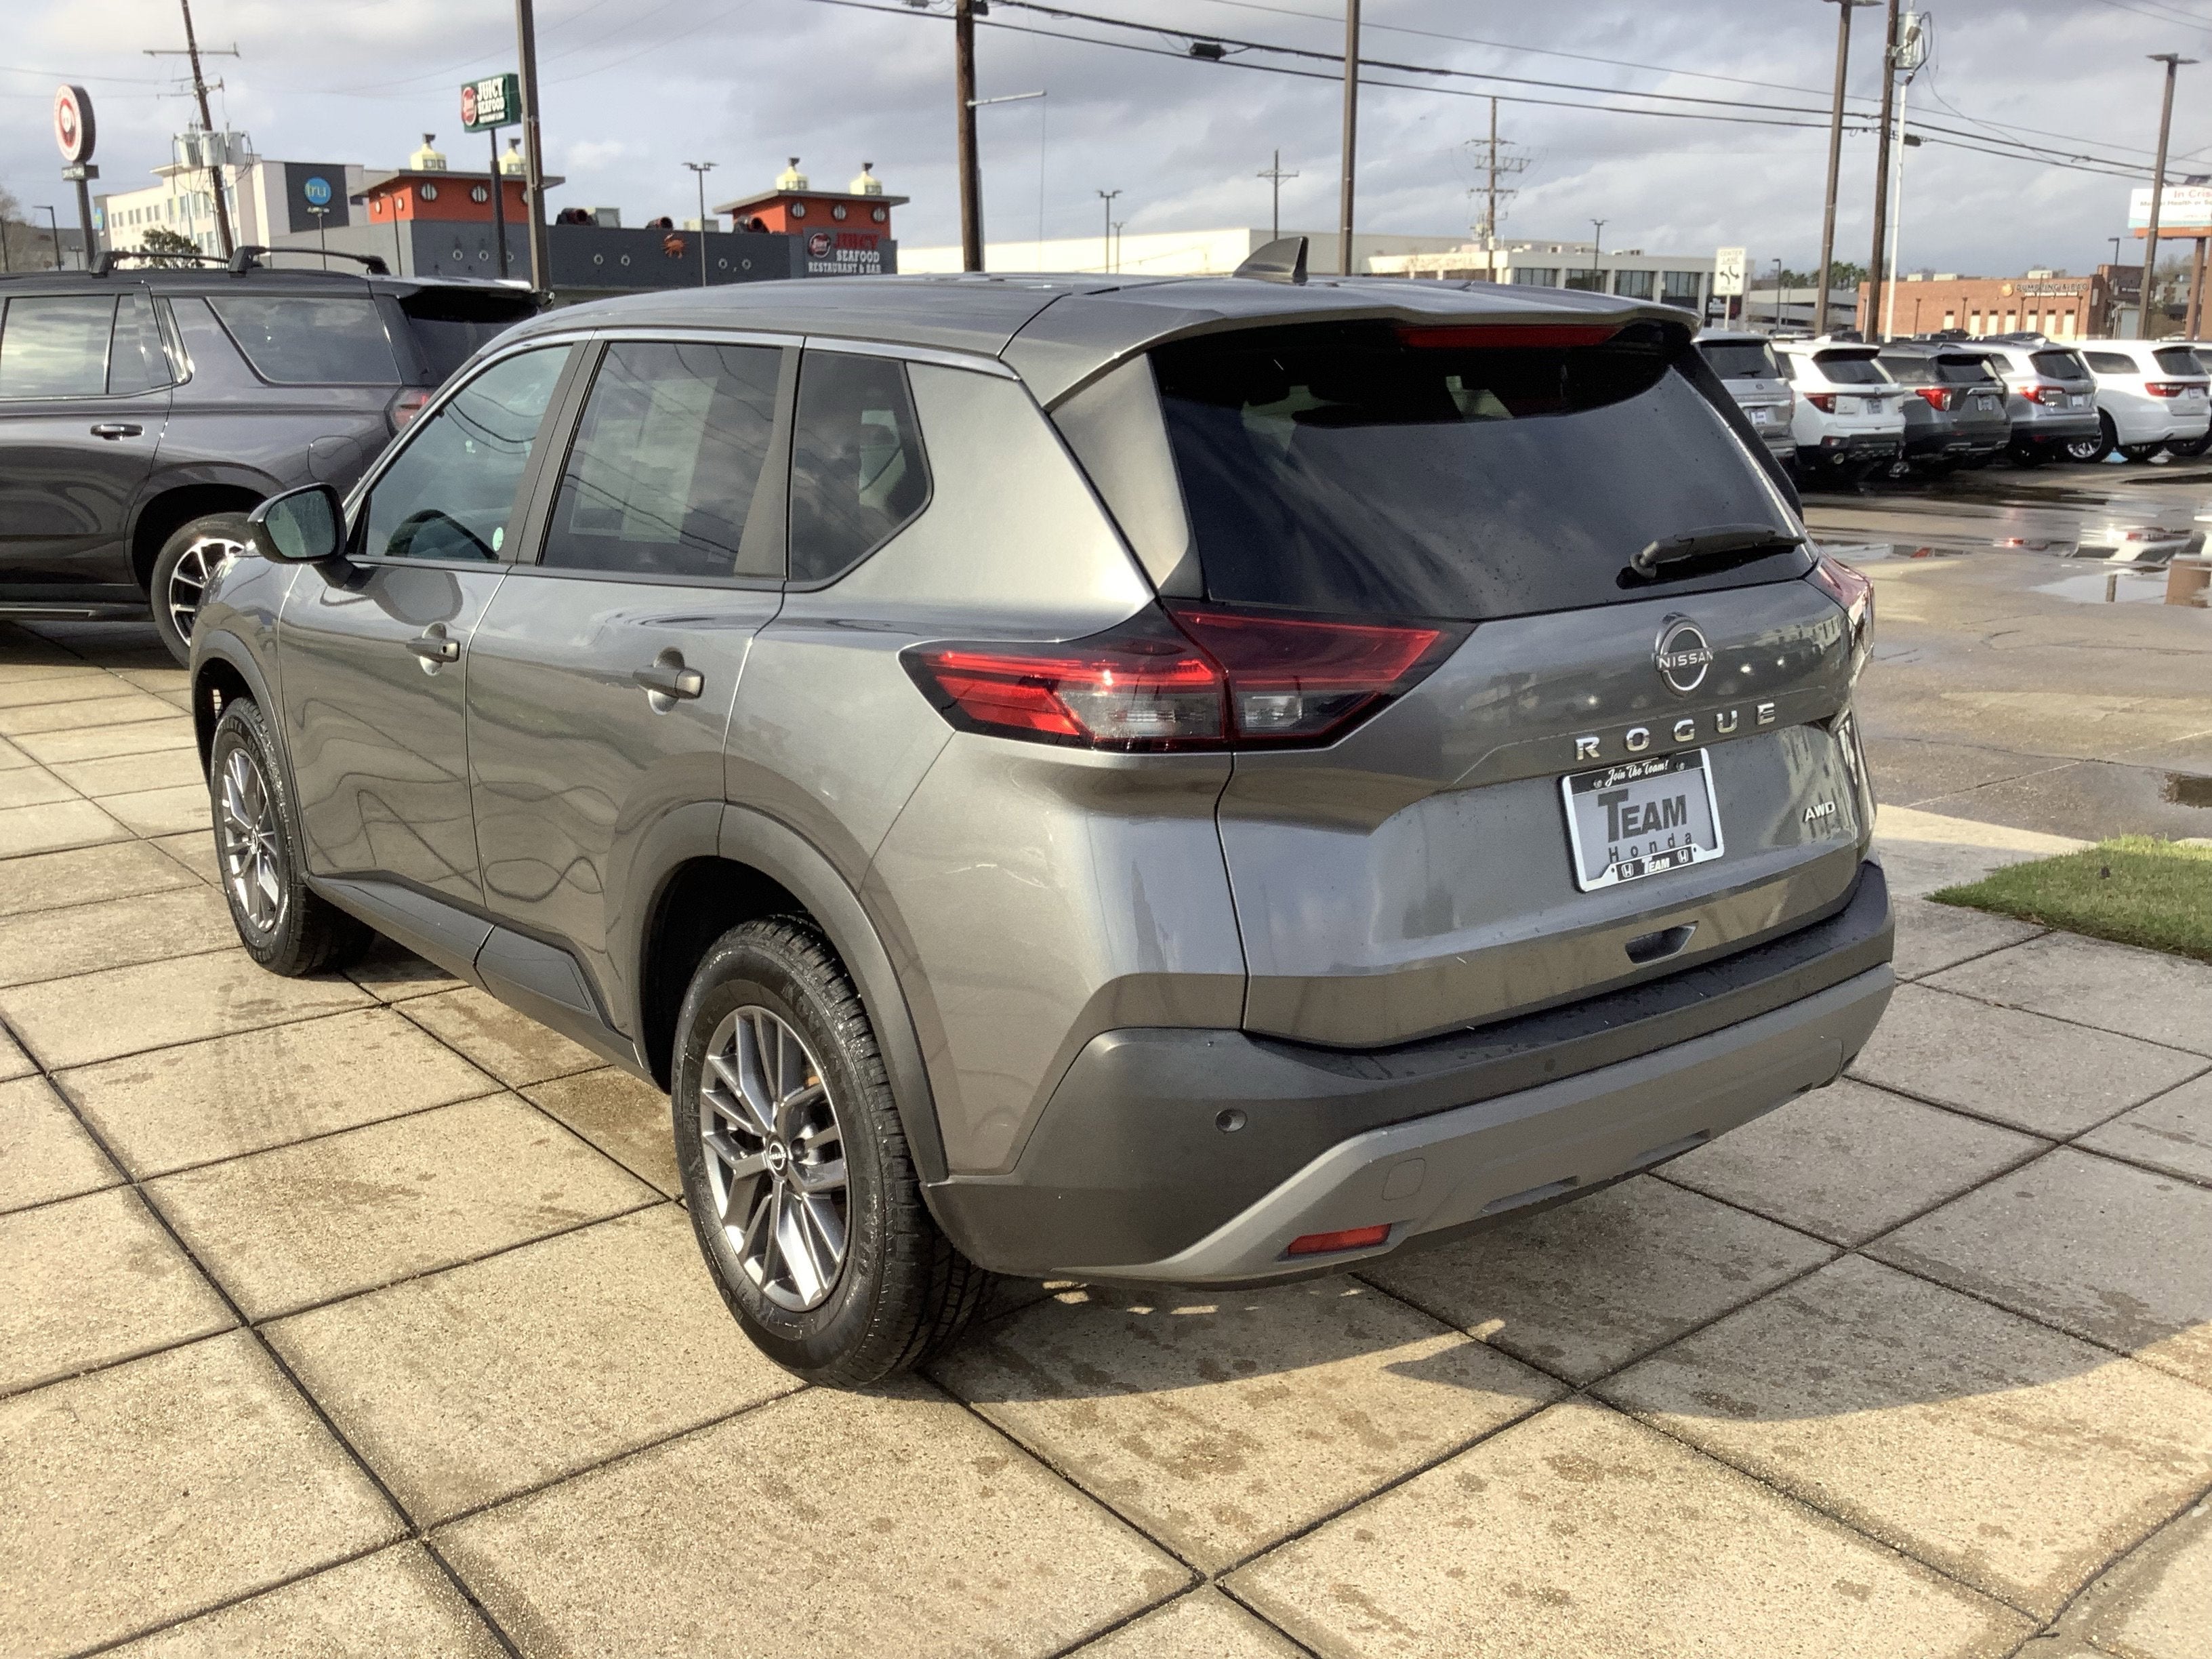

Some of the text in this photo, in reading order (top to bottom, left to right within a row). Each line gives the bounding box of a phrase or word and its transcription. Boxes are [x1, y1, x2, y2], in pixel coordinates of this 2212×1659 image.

[477, 77, 504, 102] JUICY
[478, 96, 506, 115] SEAFOOD
[836, 250, 880, 263] SEAFOOD
[808, 262, 857, 273] RESTAURANT
[1660, 651, 1714, 669] NISSAN
[1574, 702, 1776, 761] ROGUE
[1605, 759, 1669, 787] Join The Team!
[1597, 789, 1687, 843] TEAM
[1803, 801, 1836, 822] AWD
[1608, 832, 1692, 863] Honda
[1641, 857, 1671, 874] TEAM
